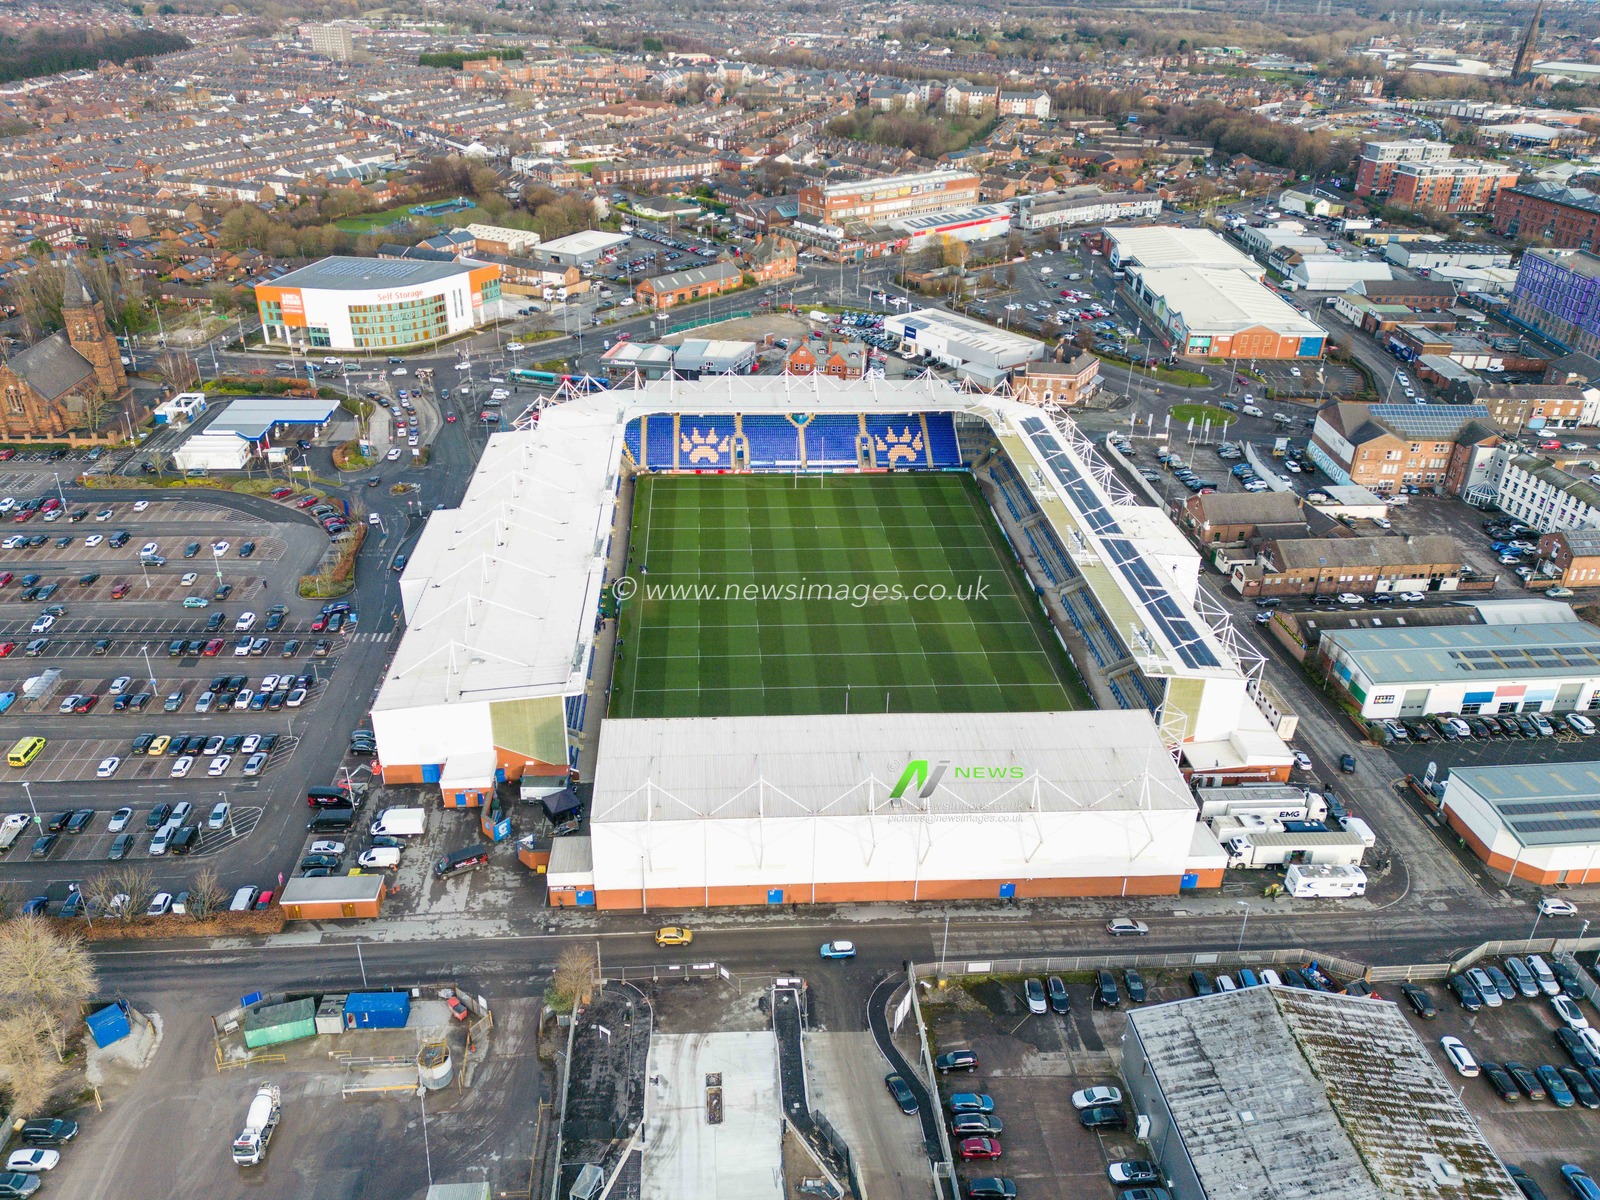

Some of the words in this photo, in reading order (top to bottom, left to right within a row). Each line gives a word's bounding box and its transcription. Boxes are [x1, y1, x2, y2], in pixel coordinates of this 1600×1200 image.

[377, 293, 392, 301] Self
[395, 289, 424, 299] Storage
[1280, 810, 1300, 818] EMG
